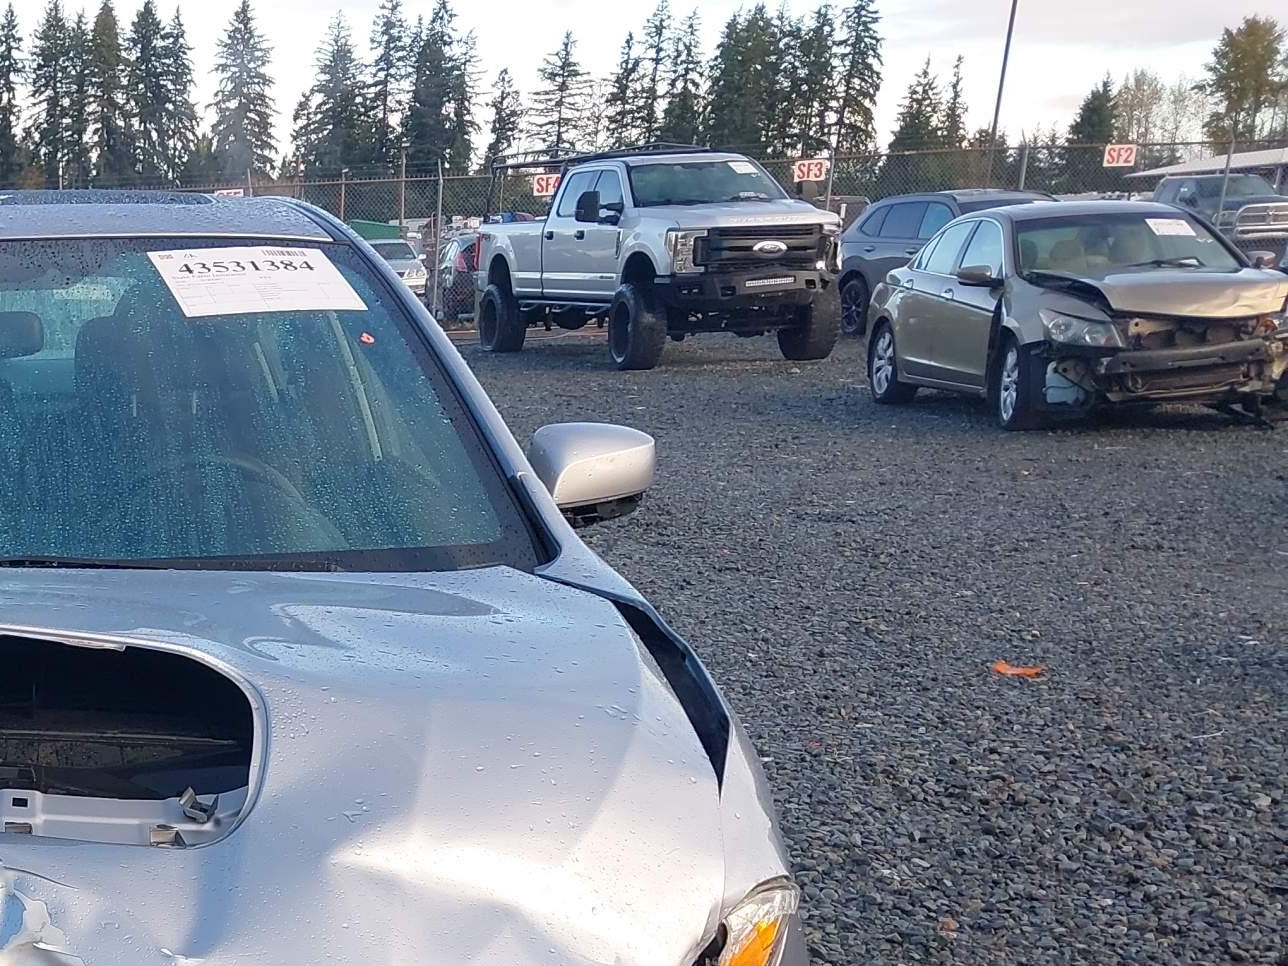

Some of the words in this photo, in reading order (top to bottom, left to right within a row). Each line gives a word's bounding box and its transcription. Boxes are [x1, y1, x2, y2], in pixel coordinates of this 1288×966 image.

[1107, 147, 1134, 164] SF2
[797, 162, 824, 179] SF3
[178, 260, 315, 274] 43531384
